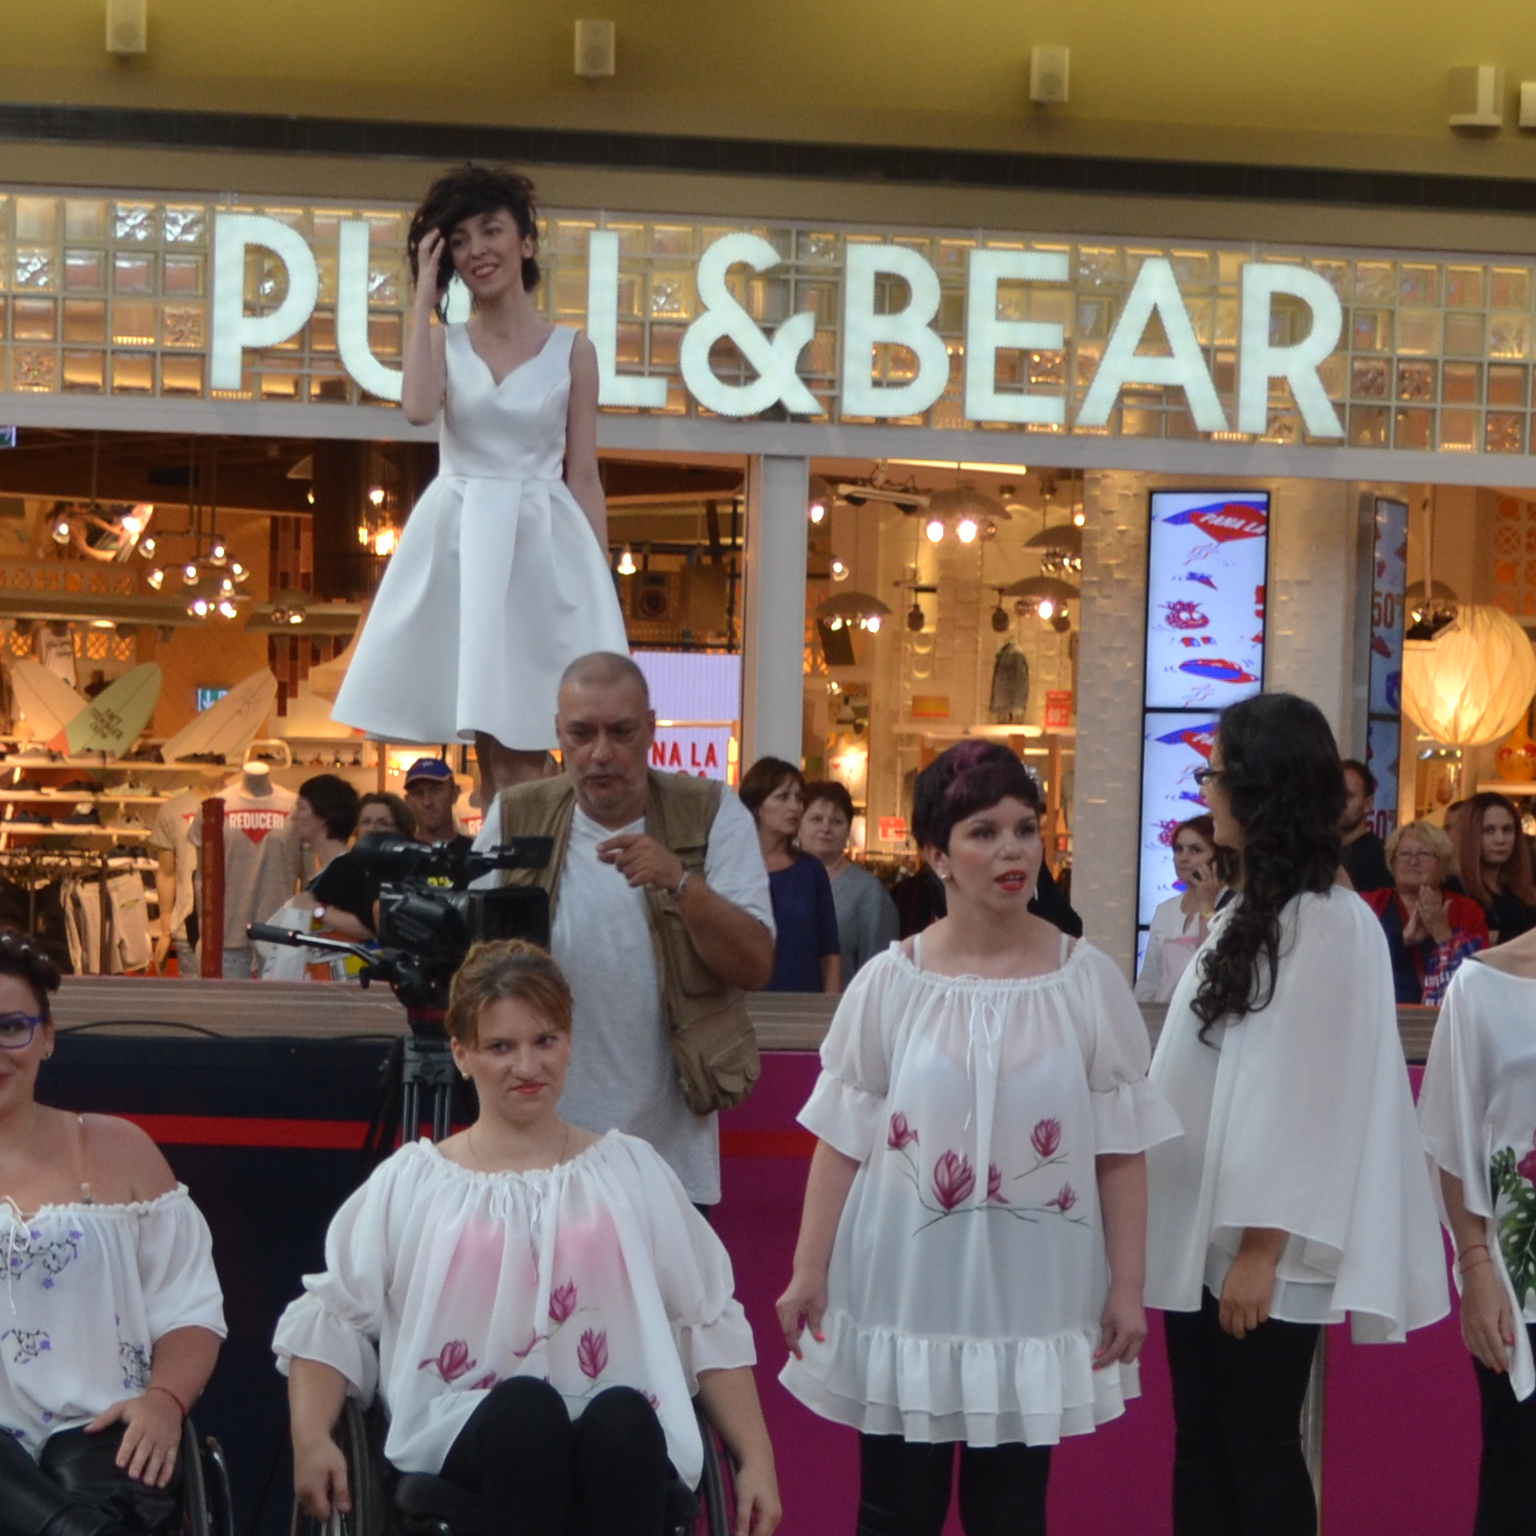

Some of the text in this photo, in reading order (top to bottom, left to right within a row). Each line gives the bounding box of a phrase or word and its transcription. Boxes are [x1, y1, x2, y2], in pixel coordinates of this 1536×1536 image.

[209, 213, 1346, 438] PUL&BEAR
[690, 741, 719, 768] LA
[229, 812, 284, 830] REDUCERI
